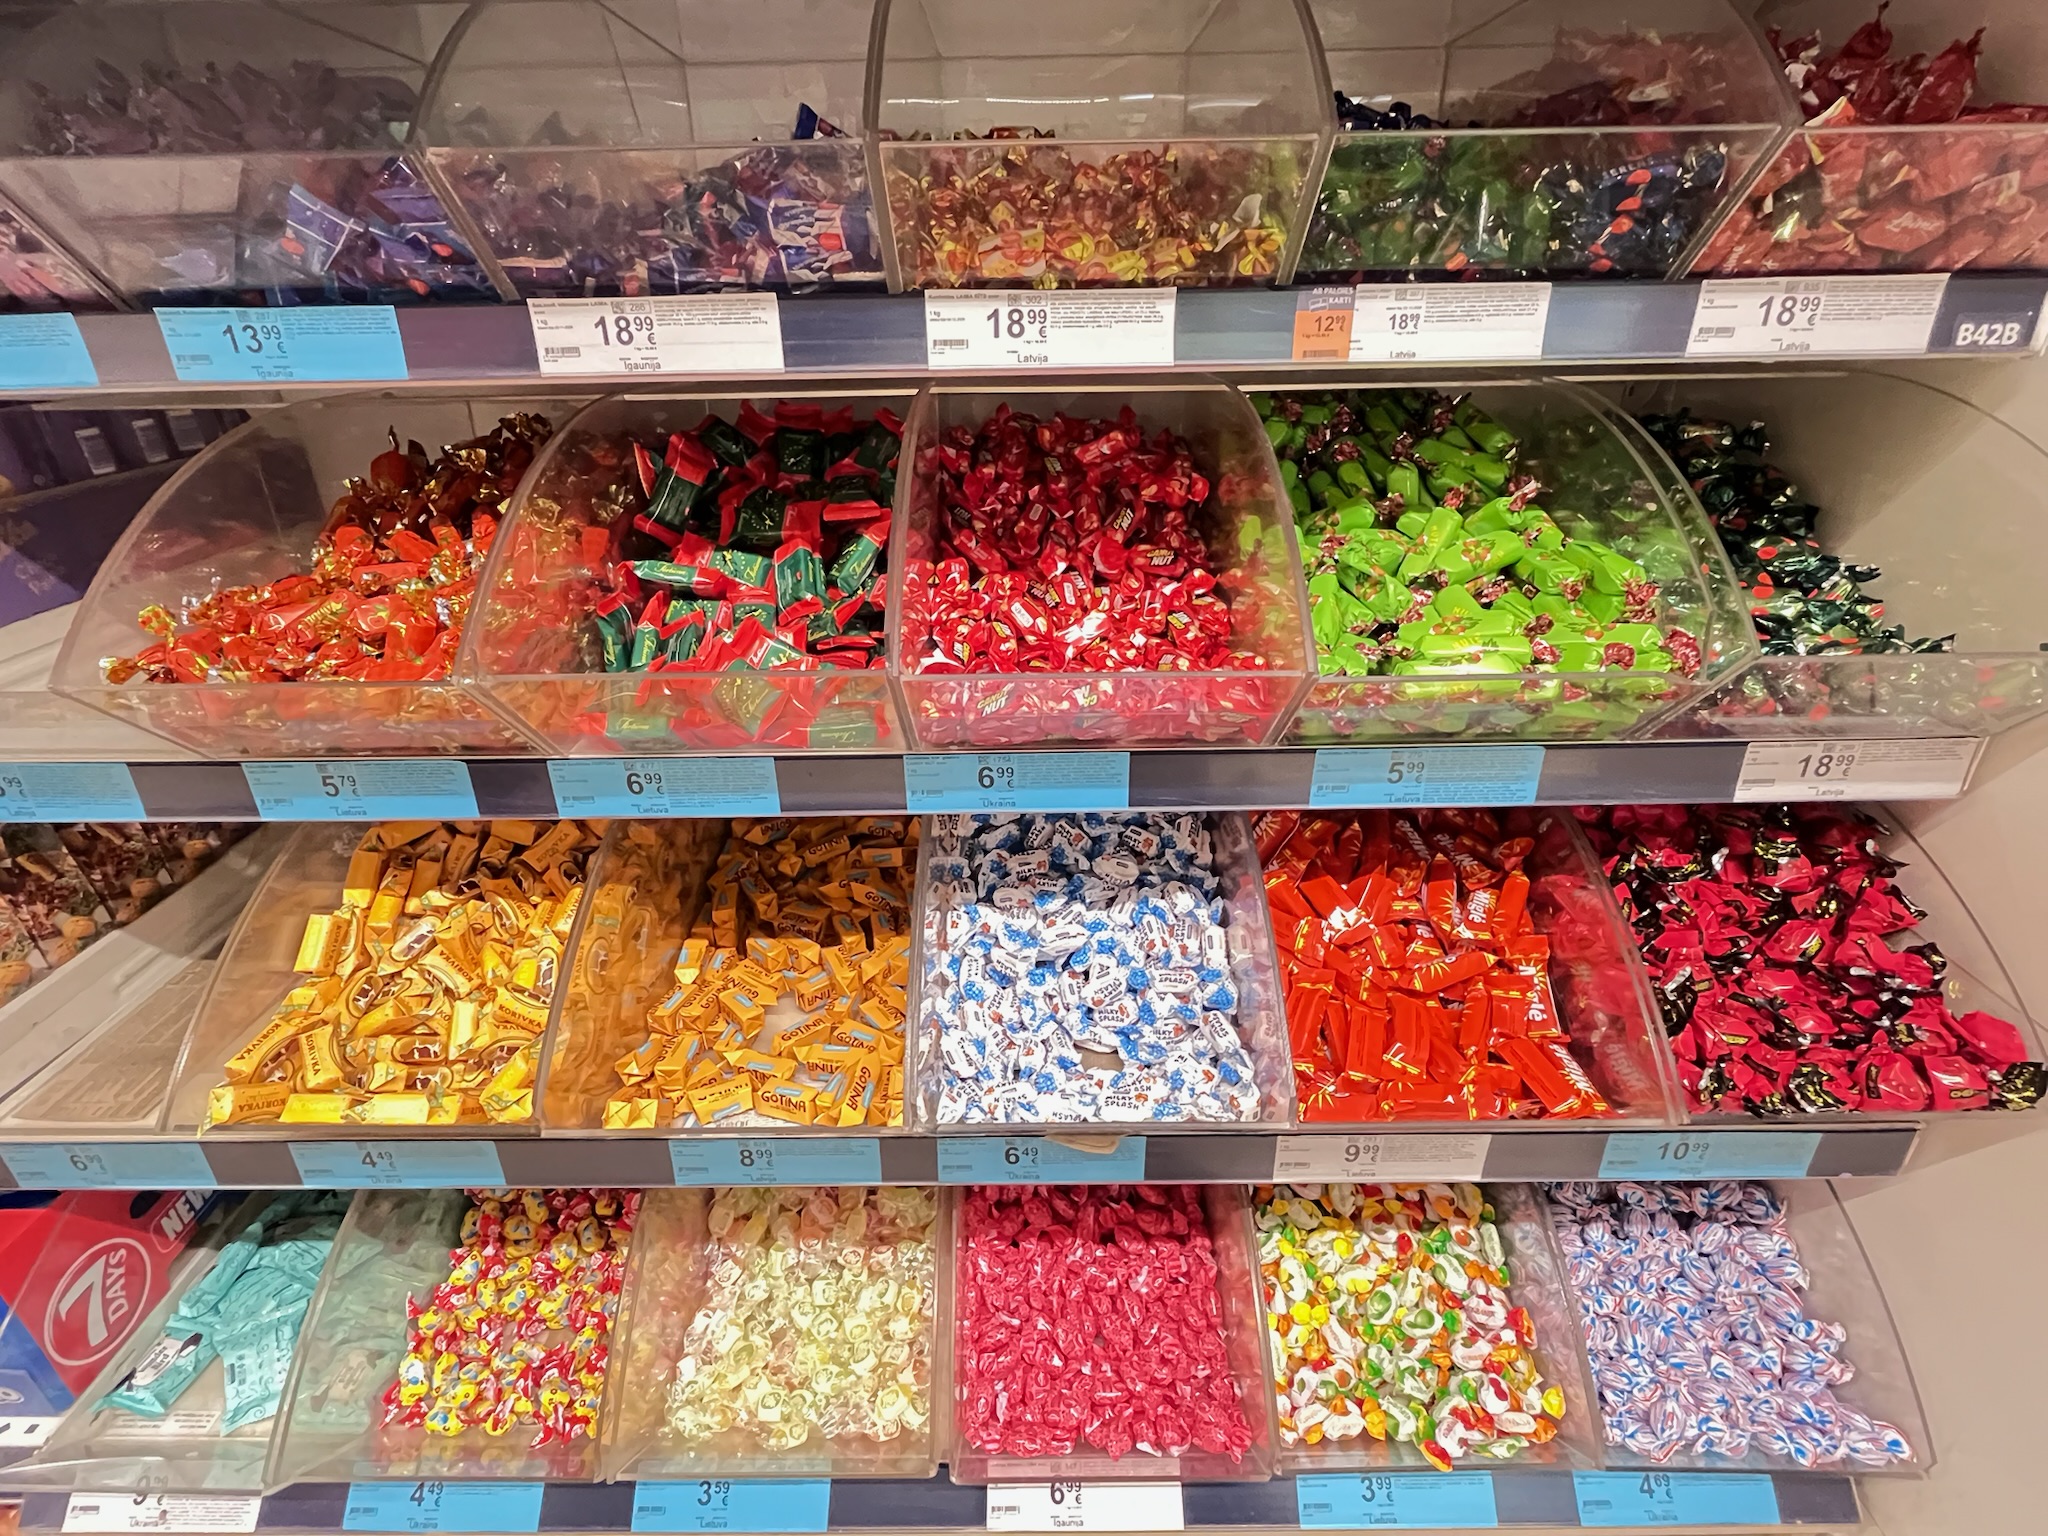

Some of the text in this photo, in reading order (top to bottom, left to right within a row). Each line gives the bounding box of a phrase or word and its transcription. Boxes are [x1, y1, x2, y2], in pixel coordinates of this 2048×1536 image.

[629, 303, 645, 311] 288
[1025, 295, 1042, 304] 302
[1329, 296, 1351, 305] KARTI
[1389, 313, 1408, 330] 18
[1759, 296, 1797, 327] 18
[595, 316, 634, 346] 18
[987, 308, 1025, 338] 18
[1314, 316, 1334, 332] 12
[1956, 322, 2021, 346] B42B
[222, 325, 264, 356] 13
[624, 361, 661, 372] Igaunija
[1017, 354, 1048, 365] Latvija
[1121, 507, 1134, 531] NUT
[1151, 555, 1175, 565] NUT
[981, 696, 1008, 717] NUT
[978, 766, 995, 788] 6
[1387, 762, 1405, 784] 5
[1798, 755, 1833, 778] 18
[322, 775, 340, 797] 5
[626, 773, 644, 795] 6
[336, 808, 367, 817] Lietuva
[637, 806, 668, 814] Lietuva
[983, 799, 1016, 807] Ukraina
[1467, 889, 1487, 924] Miglė
[439, 949, 475, 983] KORIVKA
[1158, 976, 1189, 984] SPLASH
[498, 1003, 543, 1030] KORIVKA
[782, 1018, 825, 1041] GOTINA
[236, 1022, 283, 1061] KORIVKA
[303, 1033, 322, 1077] KORIVKA
[238, 1097, 287, 1113] KORIVKA
[761, 1091, 806, 1113] GOTINA
[1104, 1101, 1140, 1110] SPLASH
[361, 1151, 377, 1168] 4
[740, 1149, 755, 1167] 8
[1004, 1147, 1020, 1165] 6
[1345, 1144, 1361, 1162] 9
[1657, 1142, 1689, 1160] 10
[70, 1155, 88, 1172] 6
[59, 1248, 129, 1347] 7 DAYS
[410, 1481, 426, 1507] 4
[697, 1481, 712, 1506] 3
[1050, 1480, 1065, 1505] 6
[1361, 1477, 1376, 1503] 3
[1640, 1474, 1655, 1499] 4
